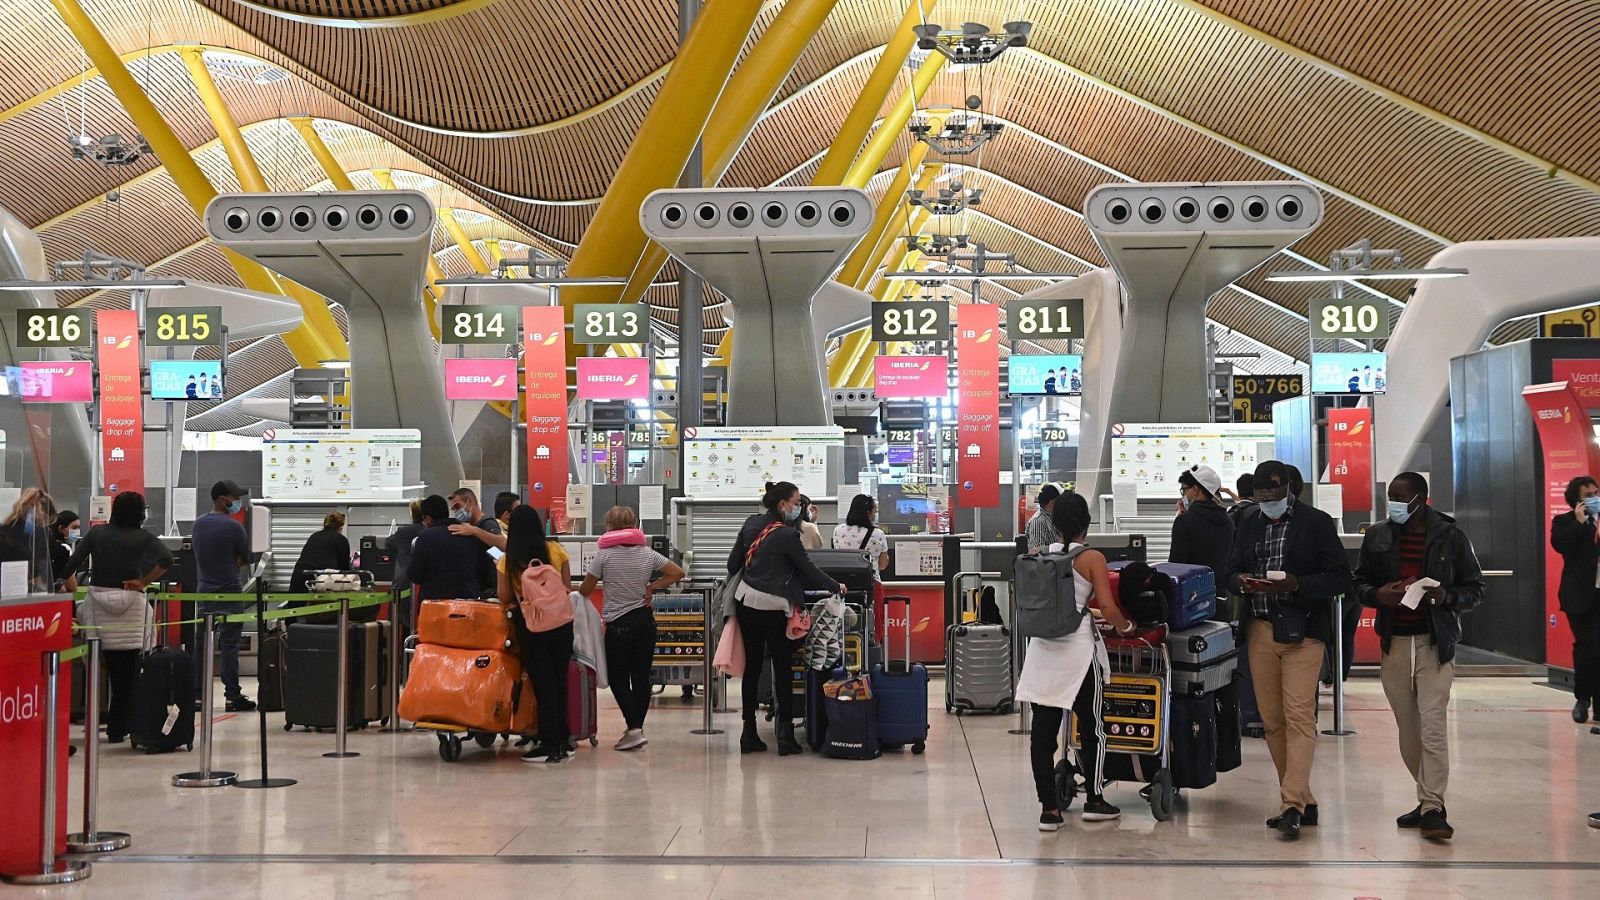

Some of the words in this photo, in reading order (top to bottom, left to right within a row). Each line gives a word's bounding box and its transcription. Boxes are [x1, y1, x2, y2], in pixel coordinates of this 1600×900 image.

[883, 308, 938, 335] 812
[1018, 307, 1072, 333] 811
[1321, 305, 1378, 332] 810
[27, 314, 81, 341] 816
[156, 314, 210, 340] 815
[454, 312, 505, 337] 814
[585, 311, 638, 337] 813
[529, 333, 542, 341] IB
[963, 330, 976, 338] IB
[103, 336, 116, 344] IB
[530, 371, 558, 380] Entrega
[963, 369, 990, 378] Entrega
[104, 375, 132, 383] Entrega
[105, 384, 114, 392] de
[1266, 378, 1301, 394] 766
[531, 392, 561, 400] equipaje
[963, 390, 993, 398] equipaje
[105, 395, 135, 403] equipaje
[963, 413, 993, 422] Baggage
[1537, 409, 1562, 419] IBERIA
[106, 418, 136, 426] Baggage
[531, 416, 561, 425] Baggage
[532, 426, 548, 434] drop
[963, 424, 979, 433] drop
[982, 424, 991, 432] off
[1334, 423, 1347, 431] IB
[107, 428, 122, 436] drop
[125, 428, 134, 436] off
[890, 430, 911, 440] 782
[1044, 430, 1066, 440] 780
[630, 432, 649, 442] 785
[1, 616, 44, 634] IBERIA
[0, 684, 38, 723] ola!
